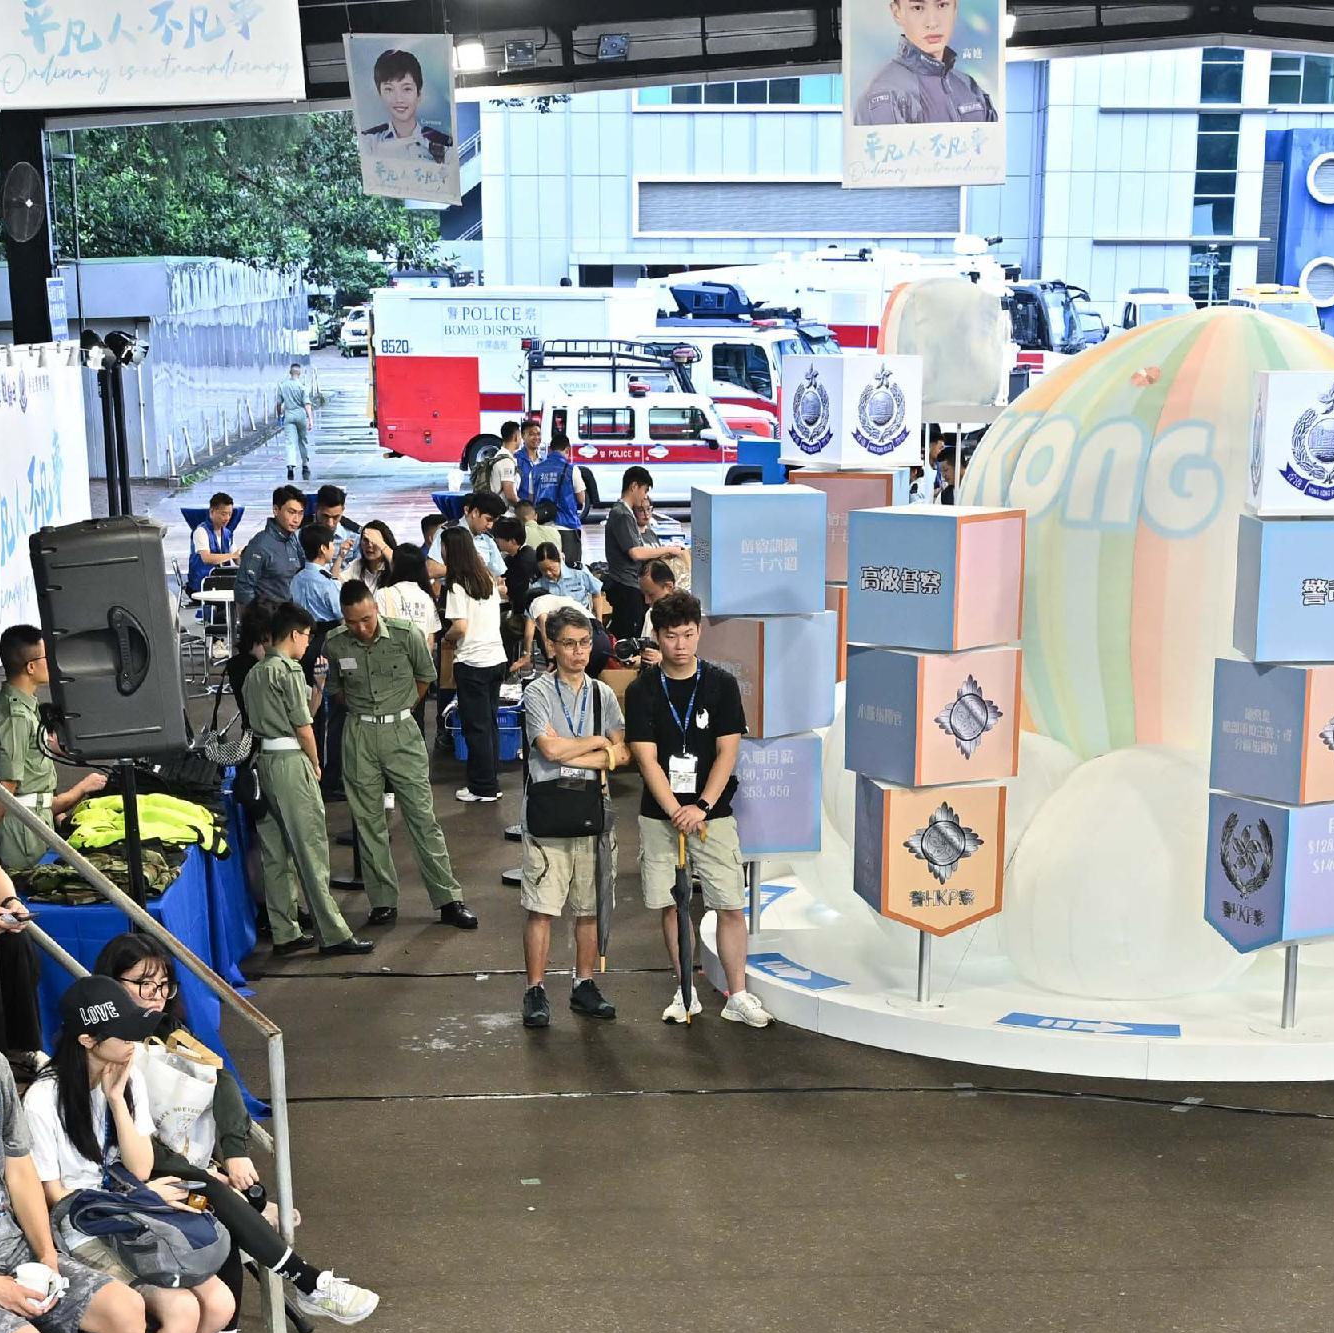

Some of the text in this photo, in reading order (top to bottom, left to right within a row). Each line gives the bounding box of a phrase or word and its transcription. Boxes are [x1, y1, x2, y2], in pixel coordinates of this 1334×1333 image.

[139, 48, 294, 88] extraordinary
[462, 307, 522, 321] POLICE
[444, 325, 540, 336] BOMB DISPOSAL
[381, 339, 409, 354] 8520
[609, 450, 632, 458] POLICE
[860, 566, 942, 594] 高級督察
[79, 1001, 119, 1026] LOVE
